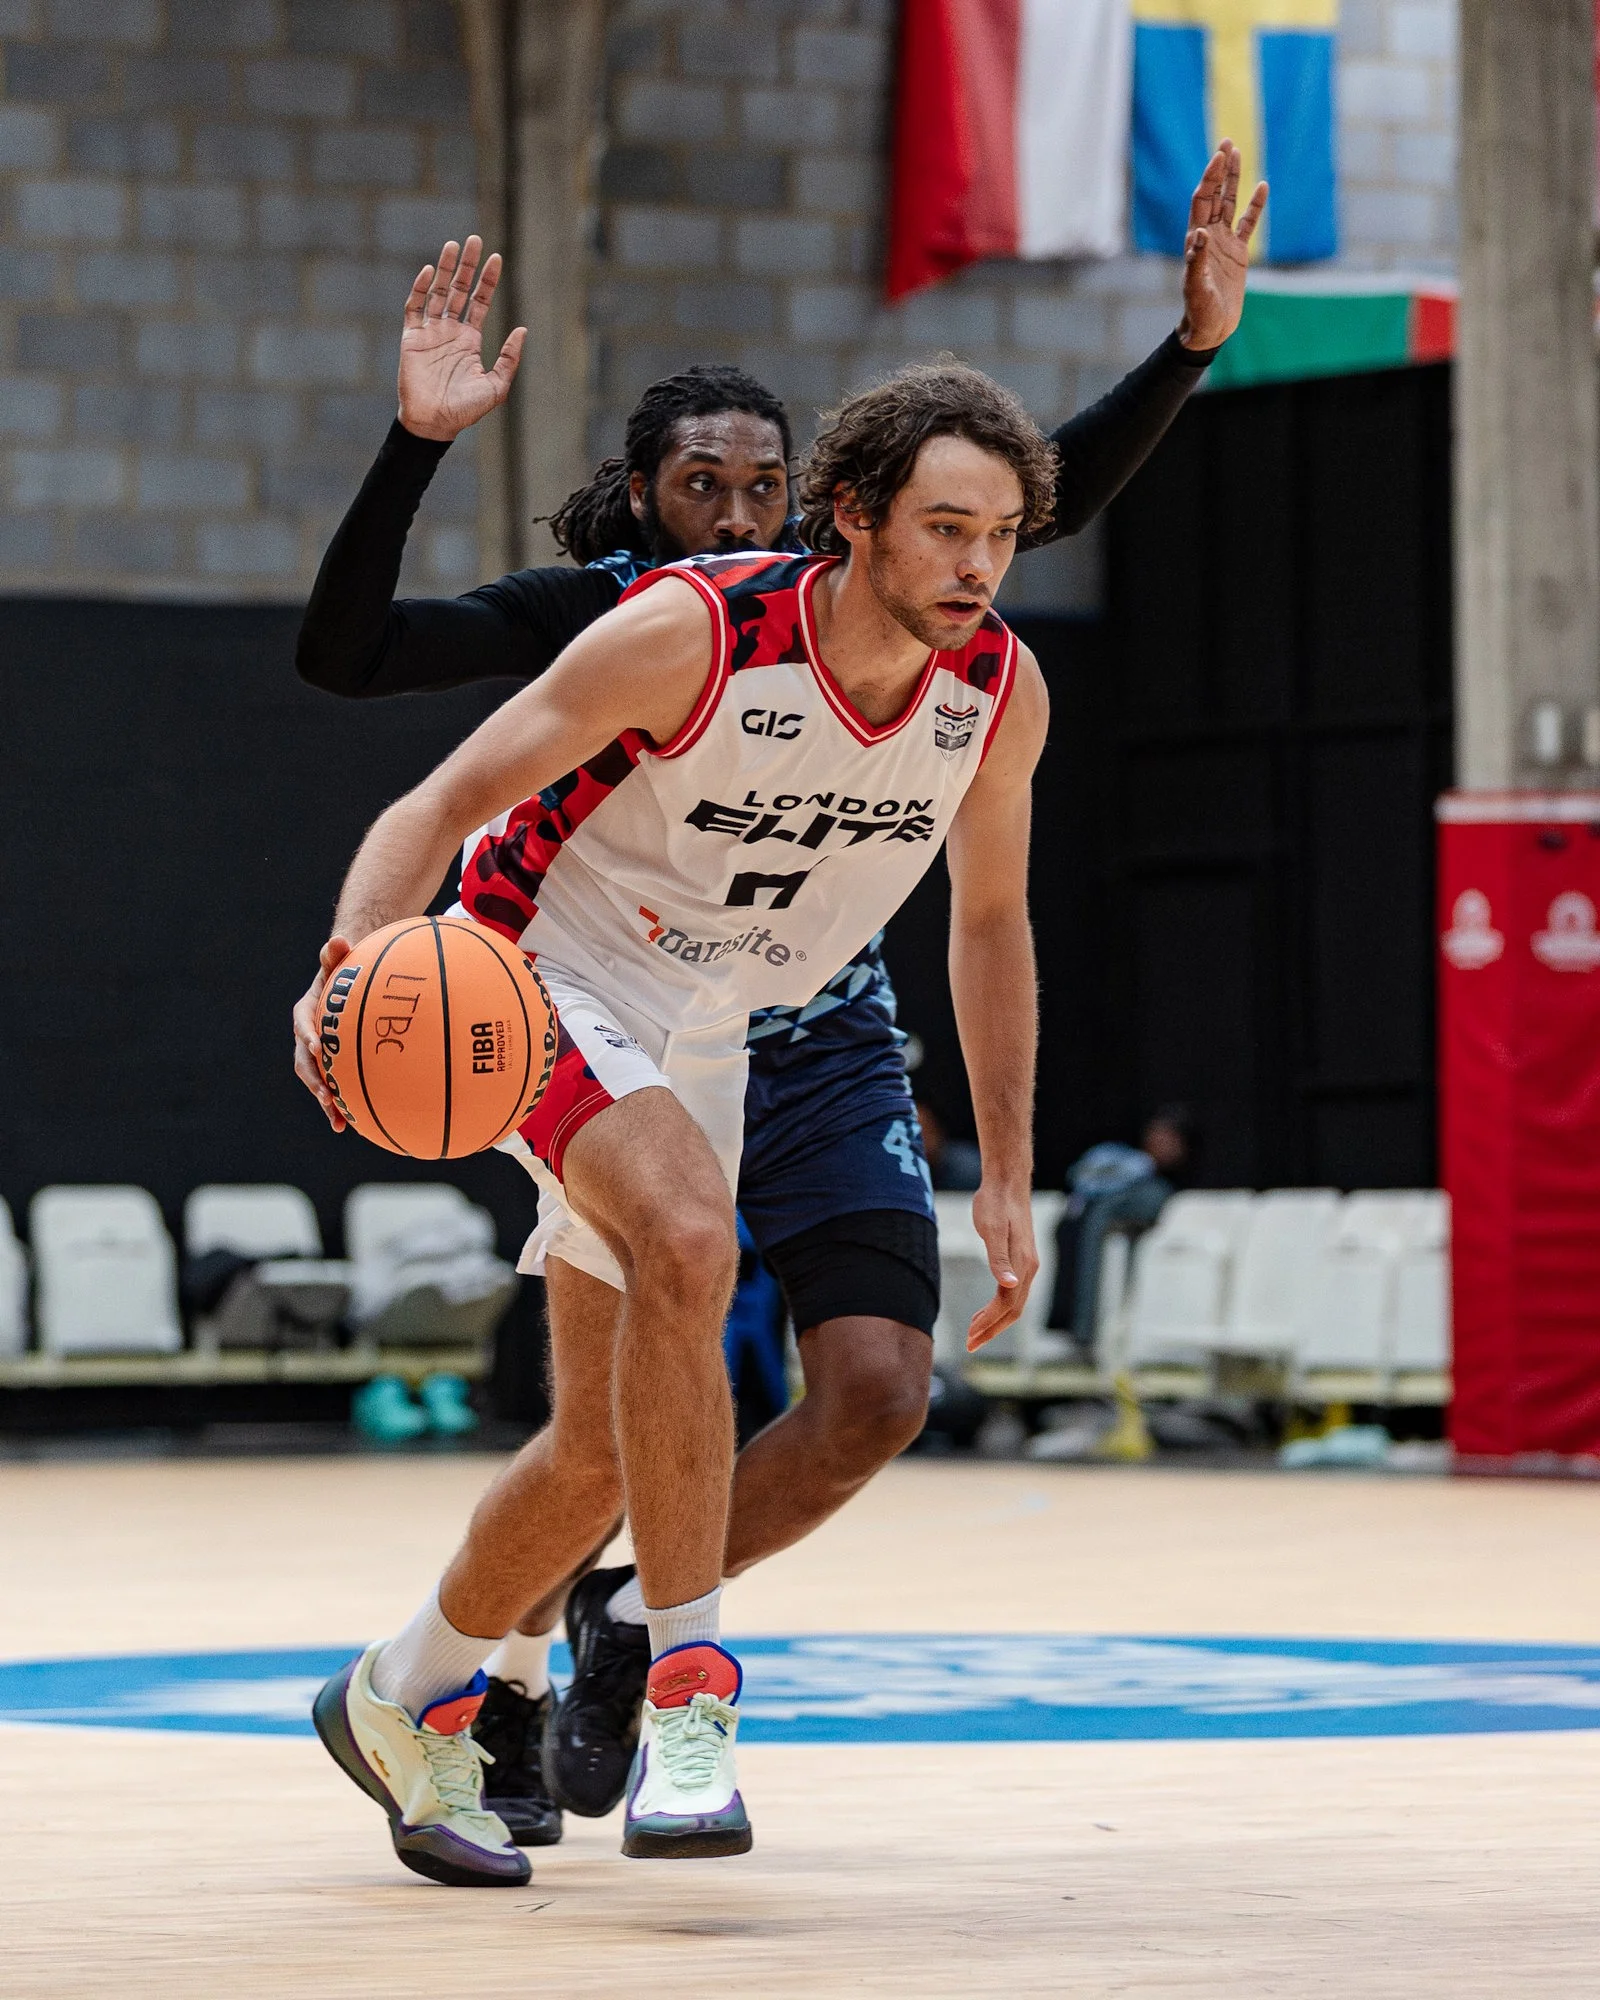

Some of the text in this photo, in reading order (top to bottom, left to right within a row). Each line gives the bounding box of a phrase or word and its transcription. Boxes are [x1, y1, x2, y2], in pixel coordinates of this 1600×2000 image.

[741, 708, 805, 740] GIS
[684, 799, 936, 850] ELITE
[743, 790, 934, 816] LONDON
[320, 965, 363, 1124] Wilson
[471, 1021, 495, 1074] FIBA
[496, 1020, 506, 1072] APPROVED
